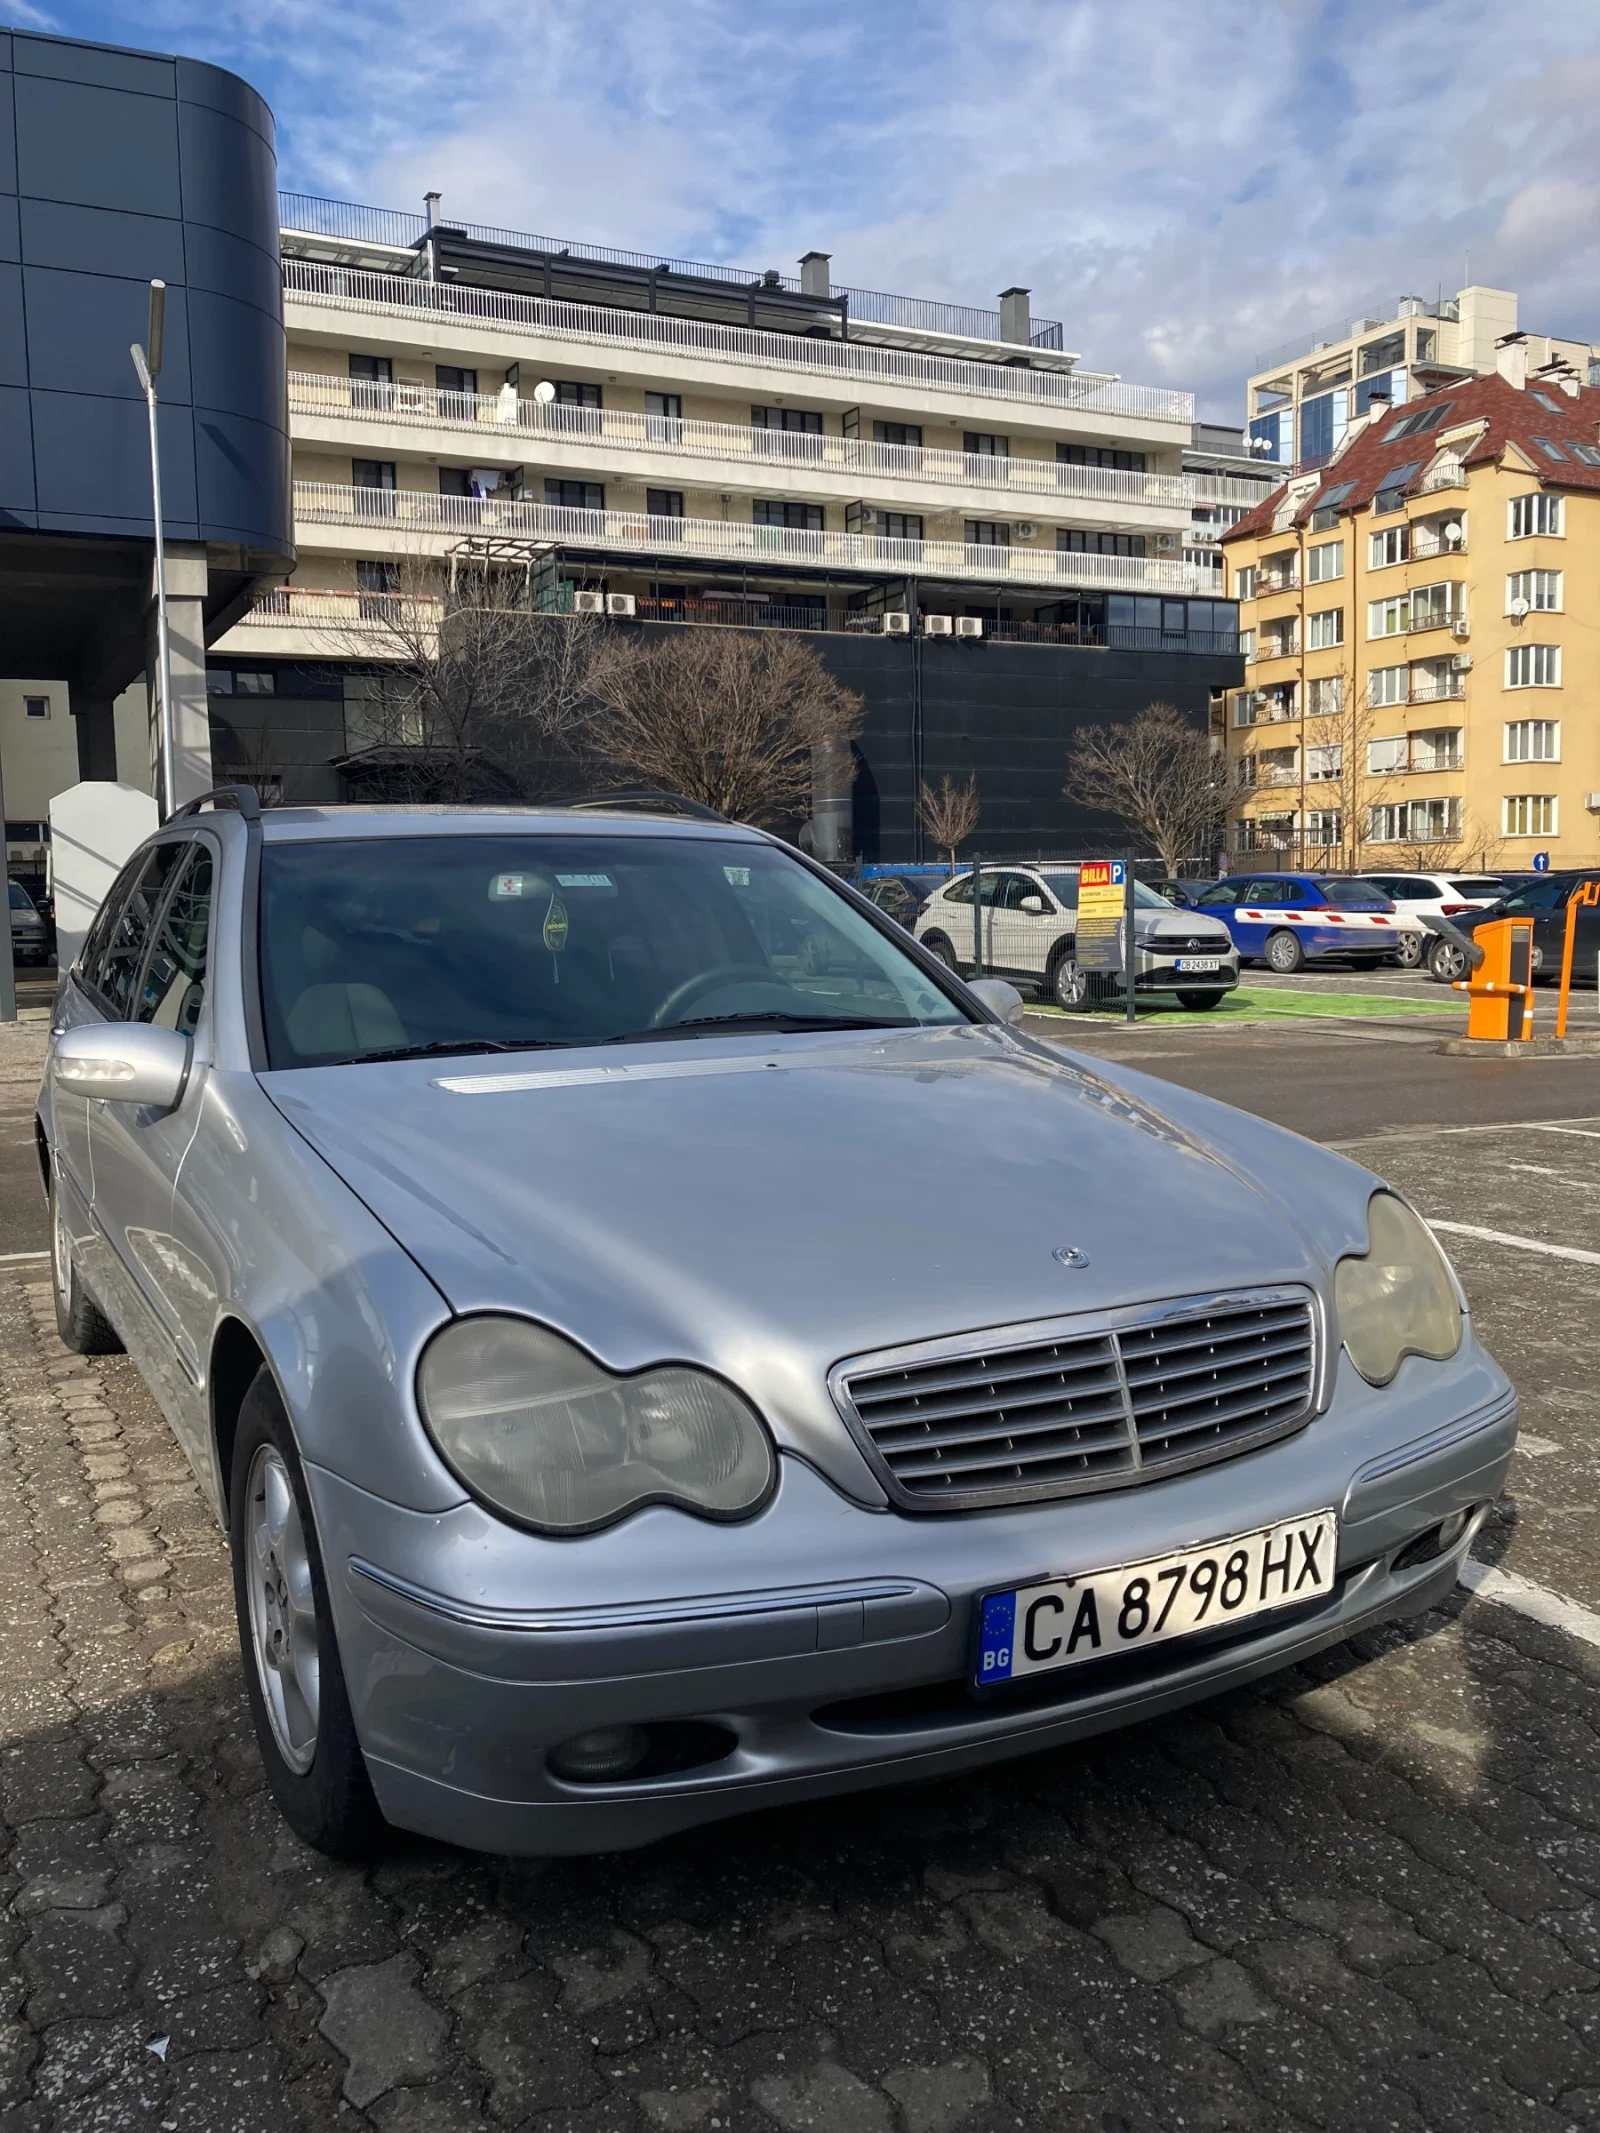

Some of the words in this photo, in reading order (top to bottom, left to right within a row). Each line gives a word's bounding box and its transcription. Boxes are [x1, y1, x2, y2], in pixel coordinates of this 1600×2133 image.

[1081, 867, 1109, 884] BILLA
[1112, 864, 1122, 883] P
[1181, 960, 1191, 970] CB
[1191, 960, 1209, 970] 2438
[1209, 960, 1218, 970] XT
[1024, 1587, 1101, 1661] CA
[1117, 1549, 1250, 1640] 8798
[1259, 1524, 1325, 1601] HX
[983, 1647, 1010, 1671] BG
